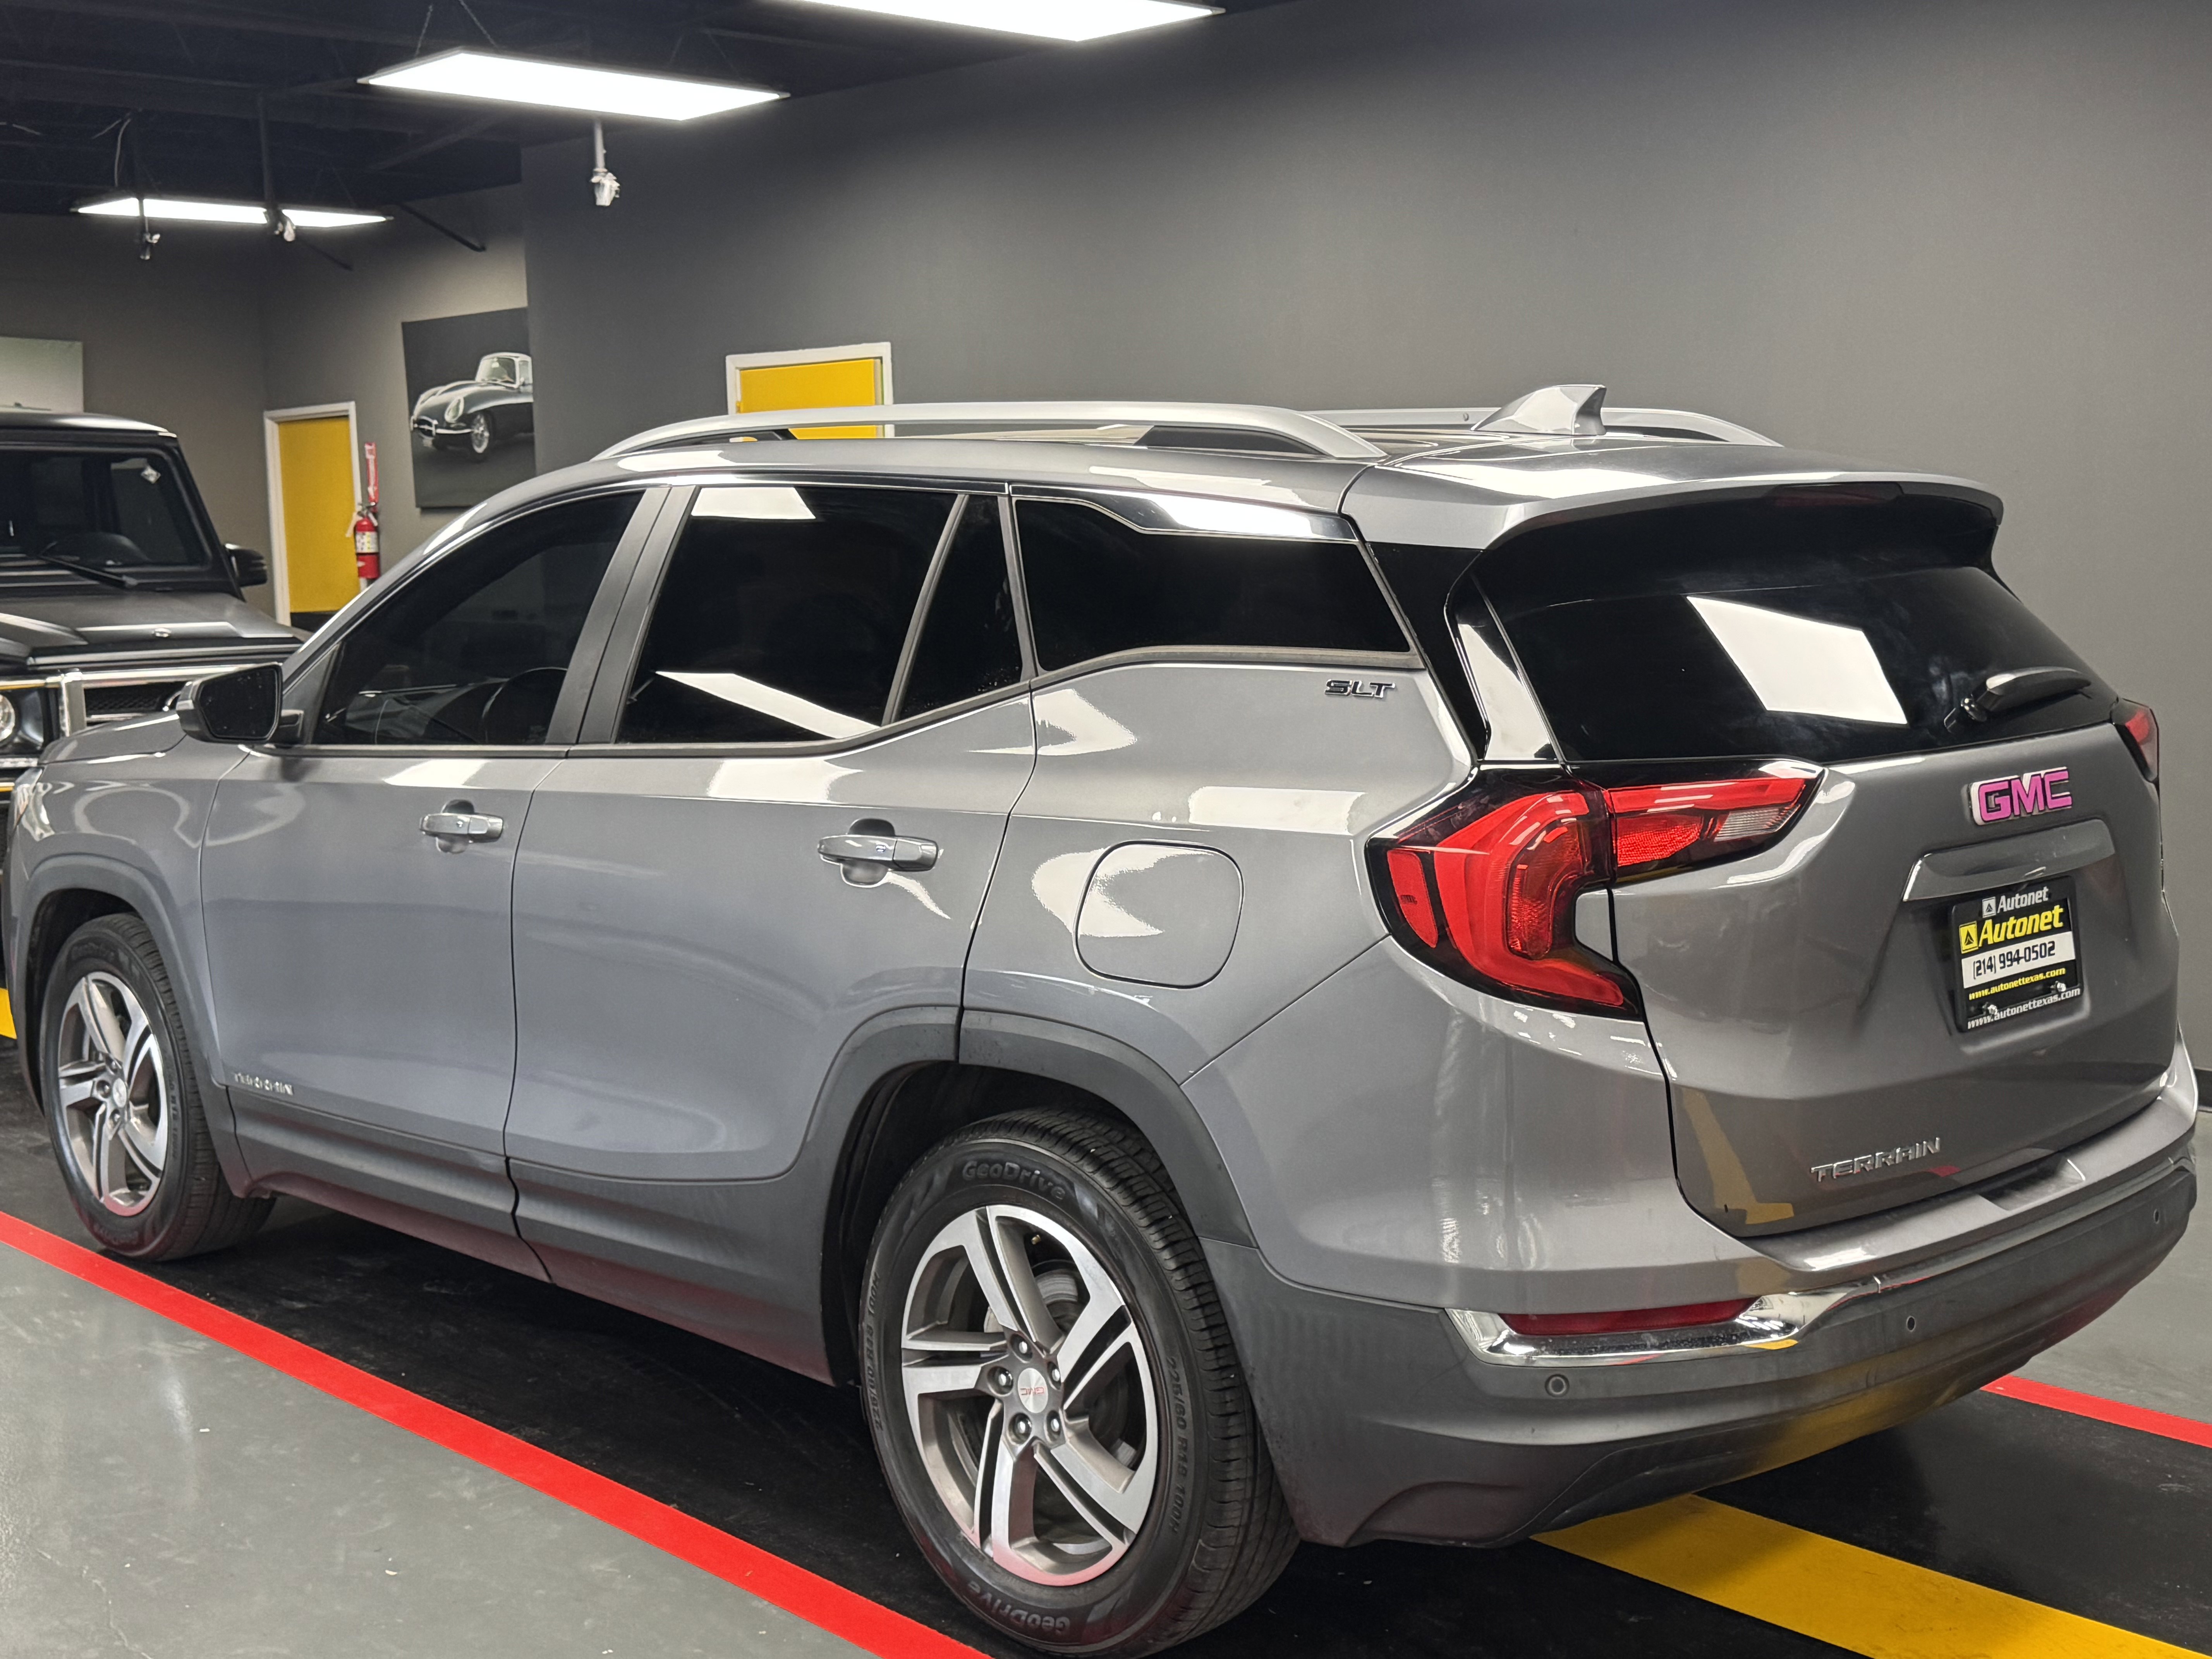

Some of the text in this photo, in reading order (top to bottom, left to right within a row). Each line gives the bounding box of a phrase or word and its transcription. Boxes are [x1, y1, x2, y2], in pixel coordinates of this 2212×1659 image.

[1324, 679, 1396, 699] SLT
[1971, 767, 2073, 825] GMC
[1997, 886, 2049, 913] Autonet
[1978, 905, 2064, 947] Autonet
[1973, 940, 2056, 980] (214) 994-0502
[1969, 967, 2066, 1000] www.autonettexas.com
[1967, 988, 2081, 1029] www.autonettexas.com
[1810, 1137, 1940, 1182] TERRAIN
[962, 1161, 1065, 1200] GeoDrive
